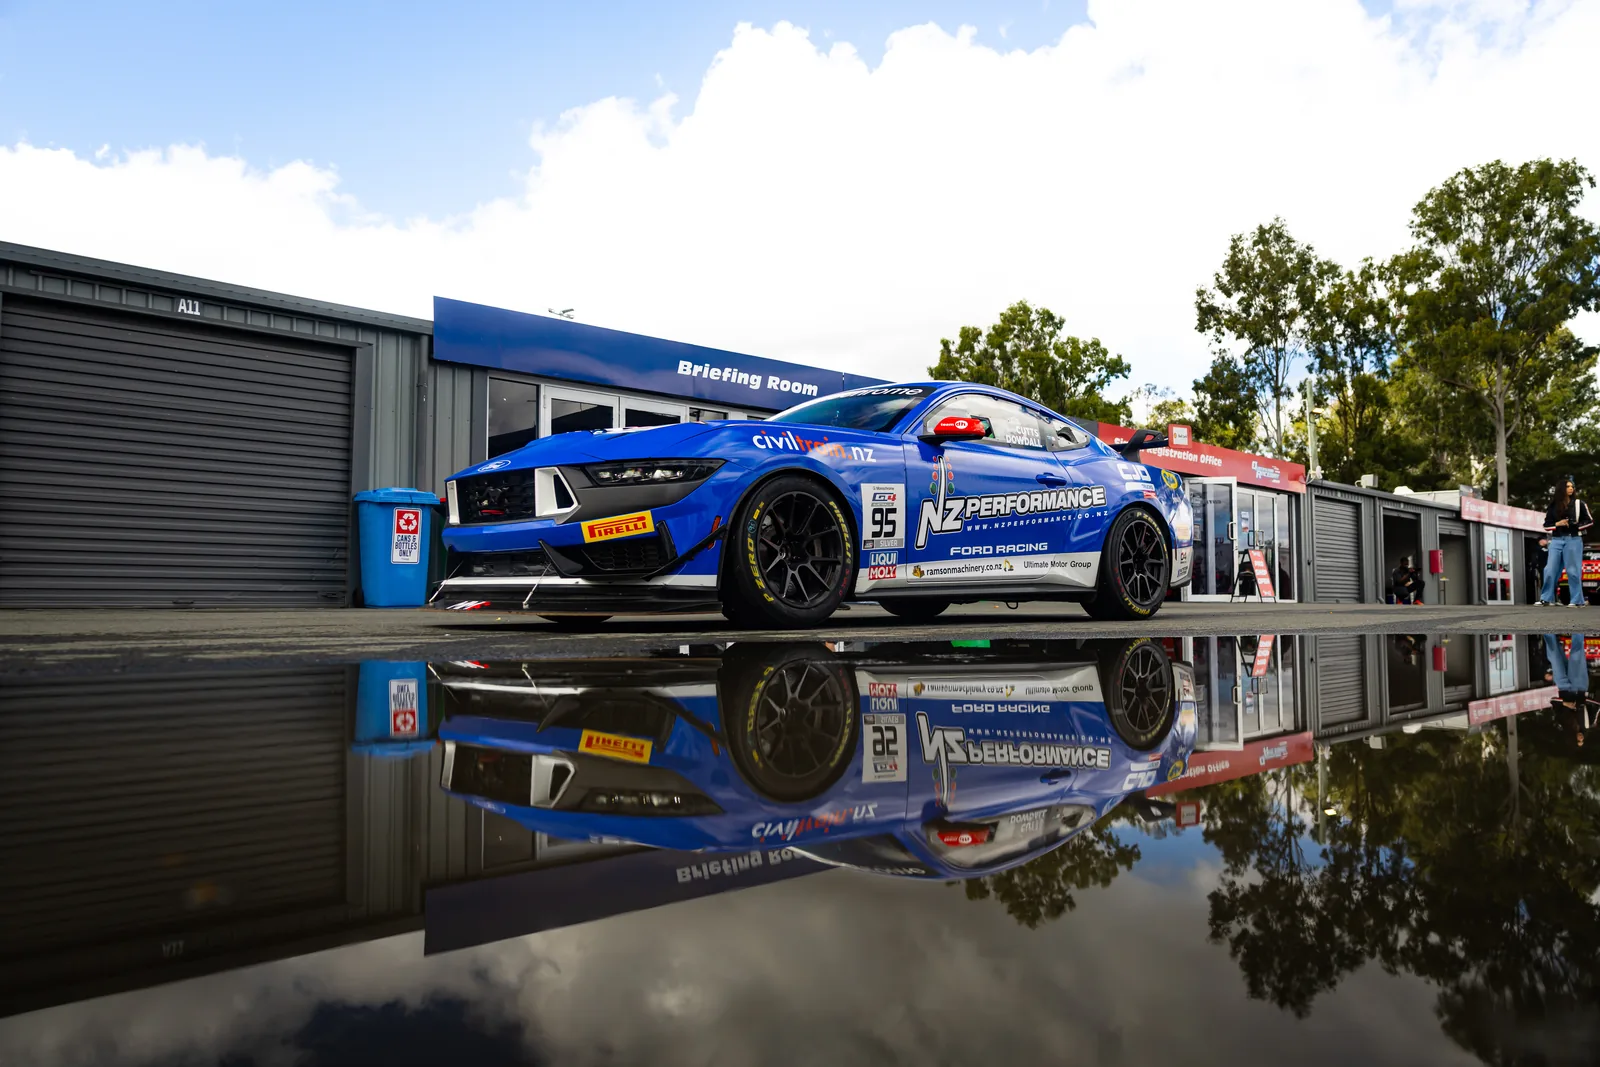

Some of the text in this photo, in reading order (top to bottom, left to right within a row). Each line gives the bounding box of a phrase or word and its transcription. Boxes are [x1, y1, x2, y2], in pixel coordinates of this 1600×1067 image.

[178, 298, 200, 315] A11
[677, 360, 818, 397] Briefing Room
[1016, 425, 1039, 438] CUTTS
[752, 430, 877, 463] civiltrain.nz
[1006, 434, 1042, 448] DOWDALL
[1200, 453, 1223, 467] Office
[966, 486, 1106, 518] PERFORMANCE
[915, 478, 967, 549] NZ
[588, 515, 647, 538] PIRELLI
[871, 508, 897, 538] 95
[395, 542, 417, 550] BOTTLES
[397, 535, 411, 543] CANS
[399, 549, 412, 557] ONLY
[950, 542, 1048, 556] FORD RACING
[871, 552, 897, 566] LIQUI
[1023, 560, 1092, 570] Ultimate Motor Group
[870, 567, 897, 579] MOLY
[926, 563, 1002, 576] ramsonmachinery.co.nz
